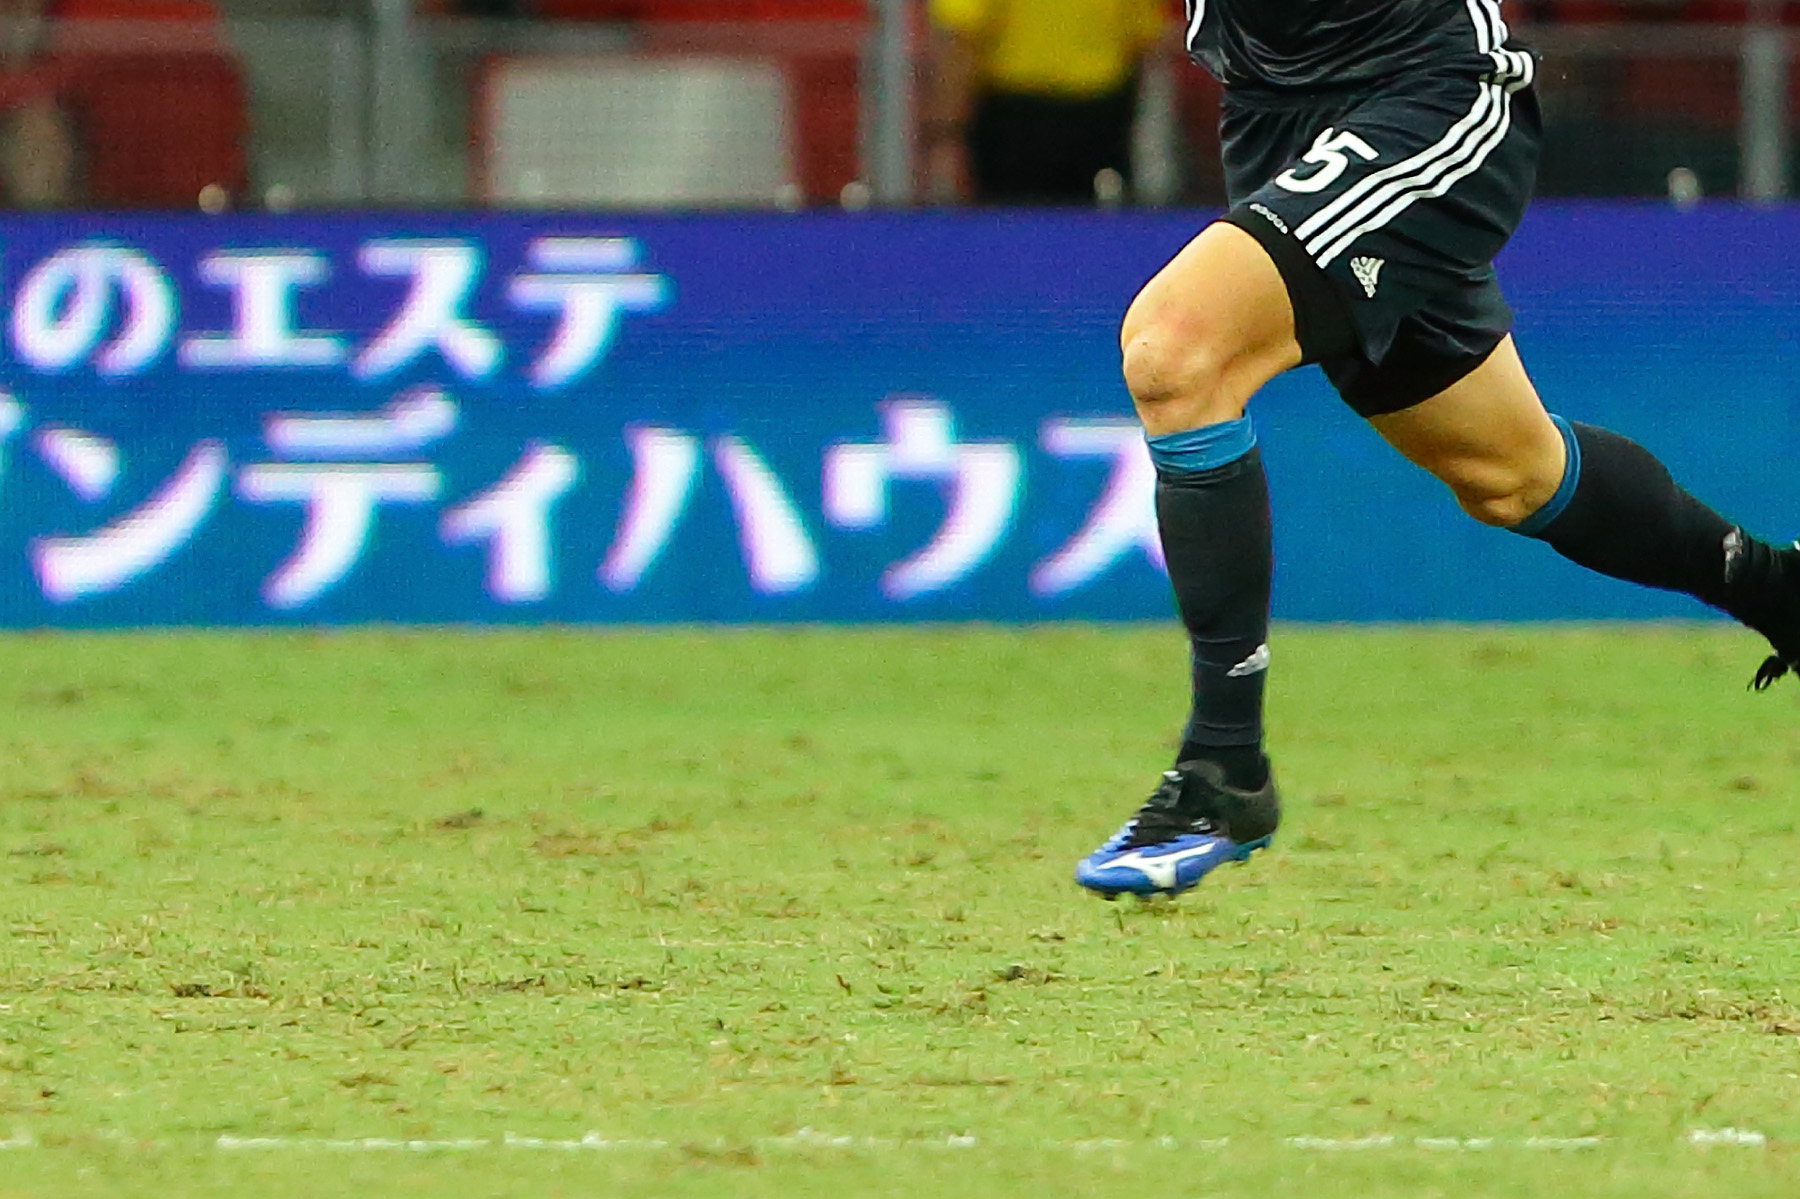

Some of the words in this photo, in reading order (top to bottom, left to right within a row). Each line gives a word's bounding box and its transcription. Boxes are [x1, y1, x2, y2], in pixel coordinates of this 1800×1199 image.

[12, 238, 672, 388] のエステ
[0, 388, 1172, 605] ンディハウス
